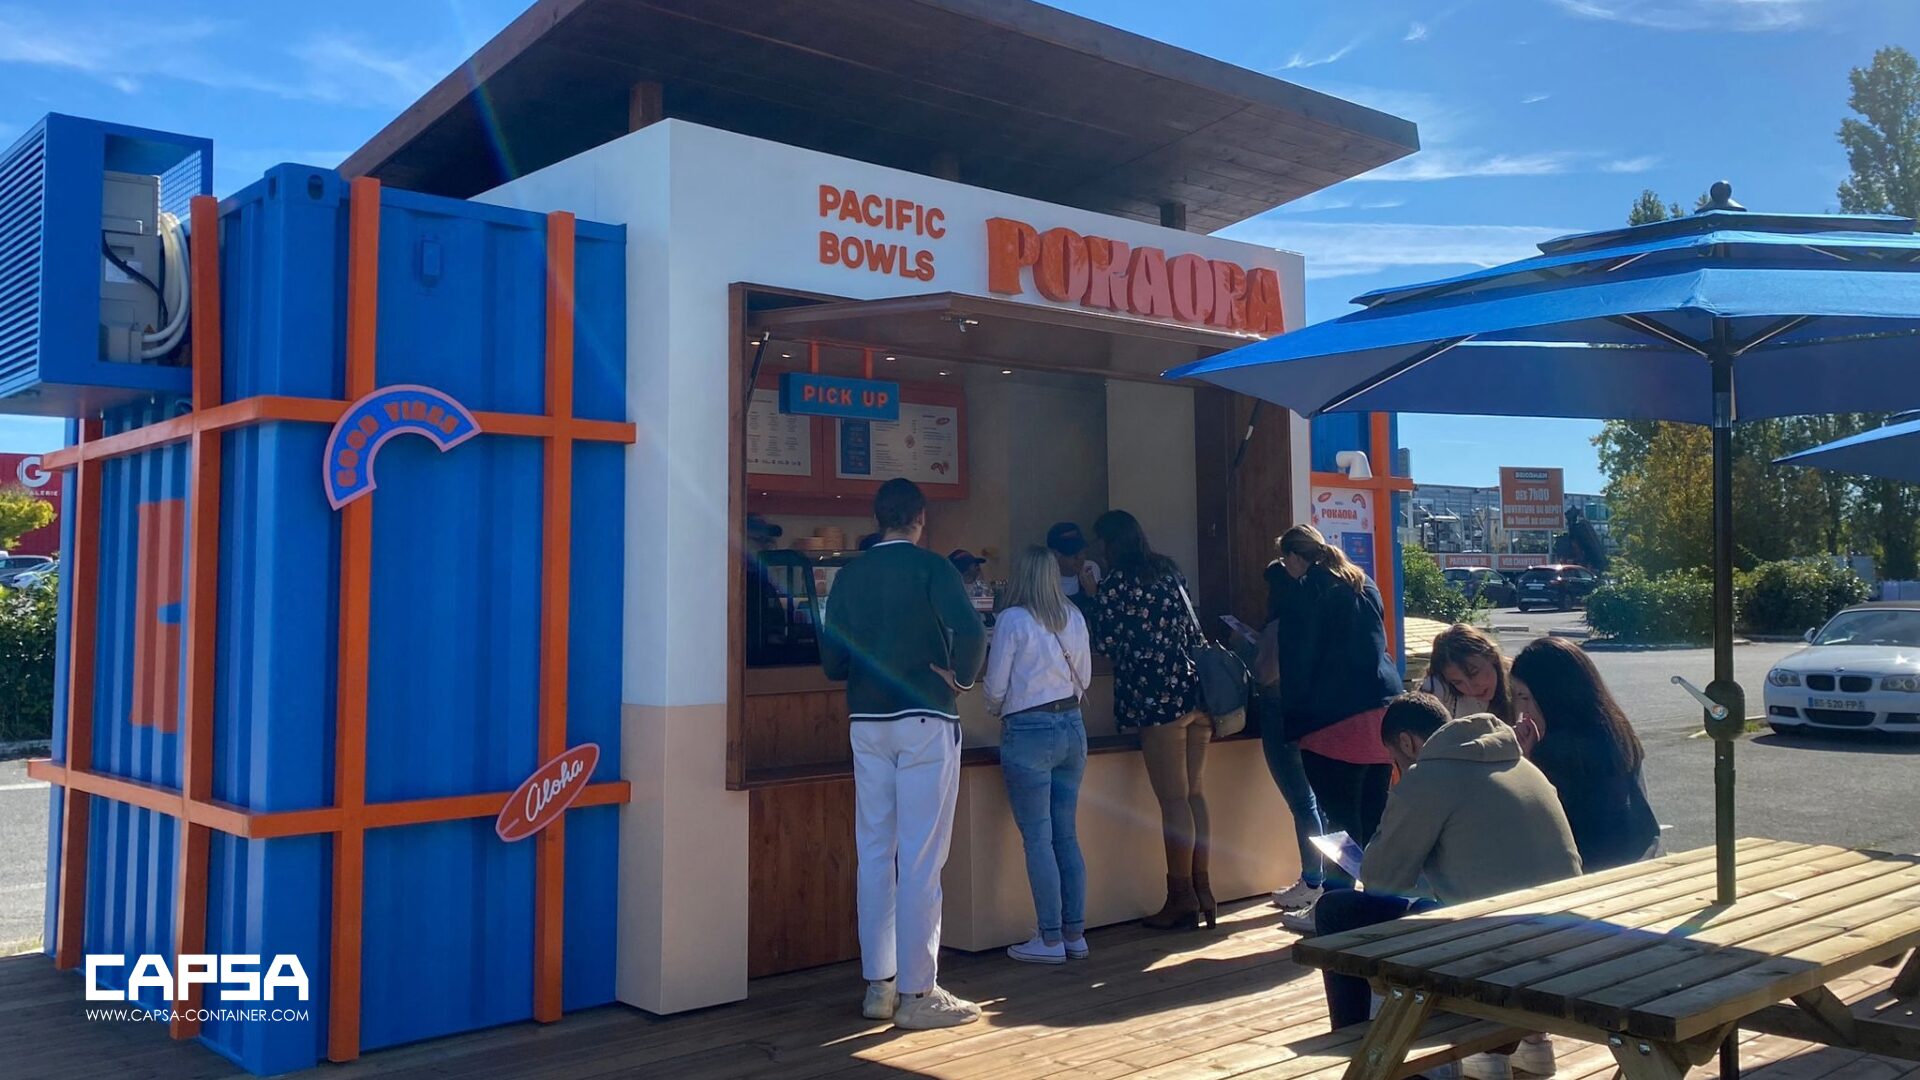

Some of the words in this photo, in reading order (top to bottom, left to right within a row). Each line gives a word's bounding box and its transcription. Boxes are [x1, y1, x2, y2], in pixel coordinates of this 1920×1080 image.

[818, 184, 946, 239] PACIFIC
[818, 231, 936, 282] BOWLS
[985, 216, 1285, 335] POKAORA
[803, 384, 852, 406] PICK
[862, 391, 889, 408] UP
[336, 415, 380, 488] GOOD
[383, 400, 460, 434] VIBES
[1321, 508, 1358, 520] POKAORA
[525, 760, 584, 822] Aloha
